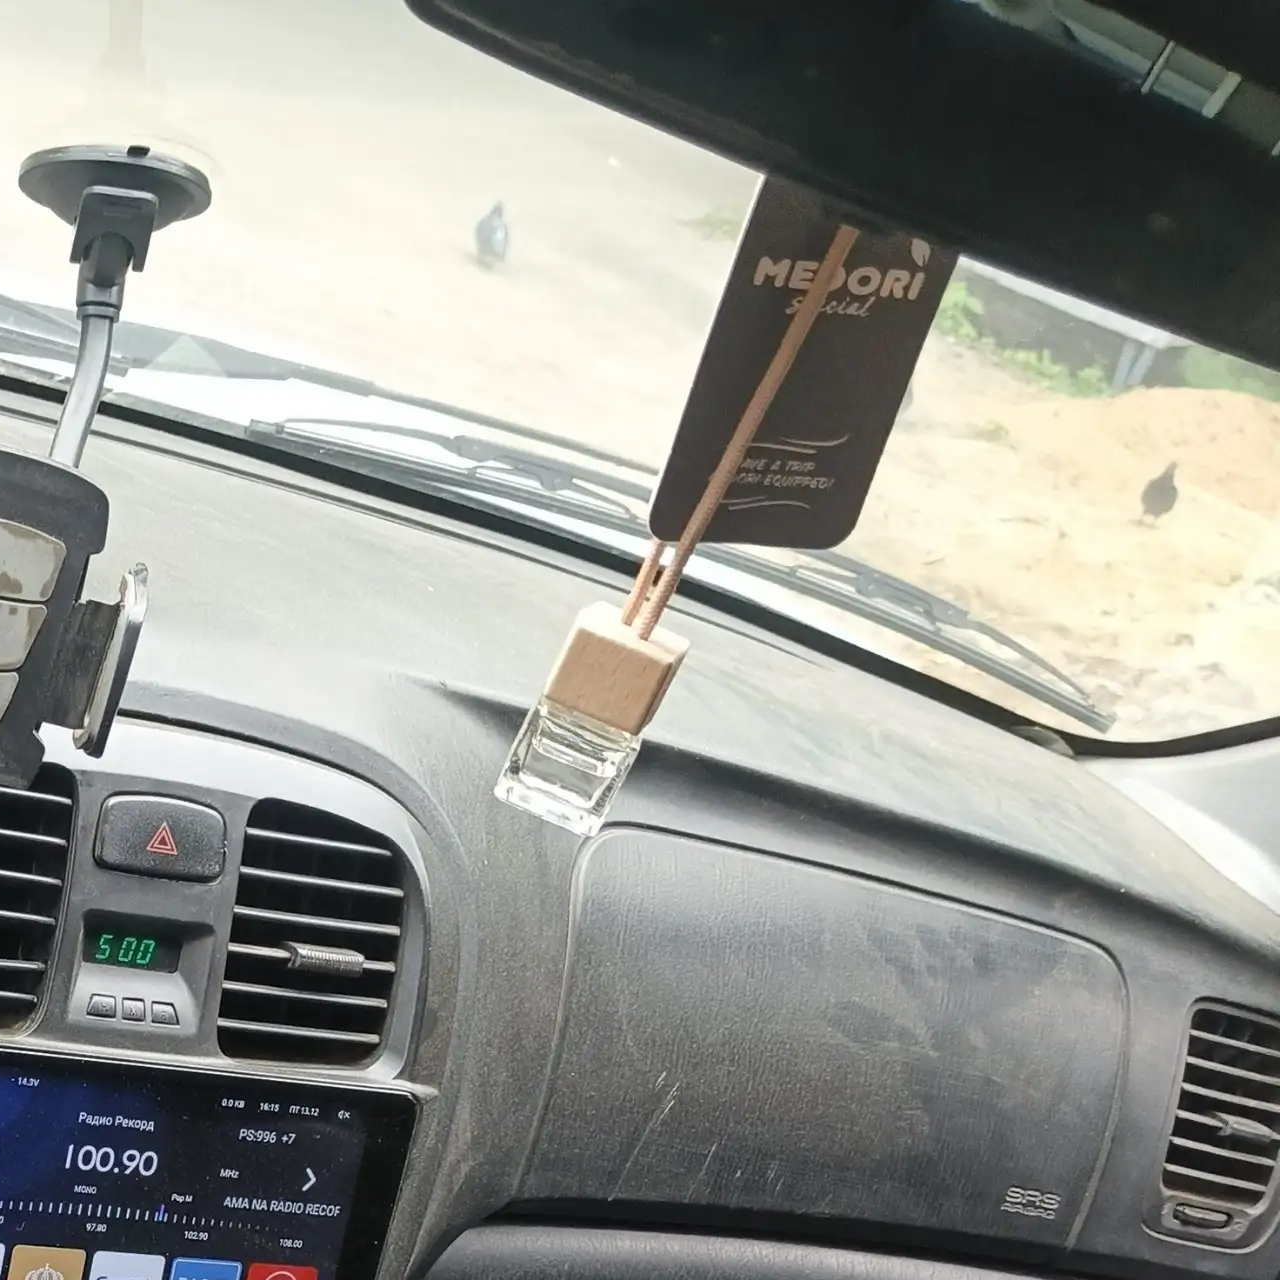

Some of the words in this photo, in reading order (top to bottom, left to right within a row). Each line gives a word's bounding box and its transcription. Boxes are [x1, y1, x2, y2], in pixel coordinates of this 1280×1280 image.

[785, 297, 875, 318] Scial
[259, 1102, 280, 1112] 16:15
[78, 1111, 113, 1127] Радио
[114, 1115, 155, 1132] Рекорд
[281, 1133, 296, 1145] +7
[64, 1144, 159, 1177] 100.90
[219, 1168, 240, 1179] MHz
[73, 1185, 98, 1195] MONO
[223, 1196, 249, 1210] AMA
[251, 1198, 268, 1211] NA
[269, 1200, 304, 1214] RADIO
[1004, 1186, 1061, 1210] SRS
[184, 1231, 209, 1241] 102.90
